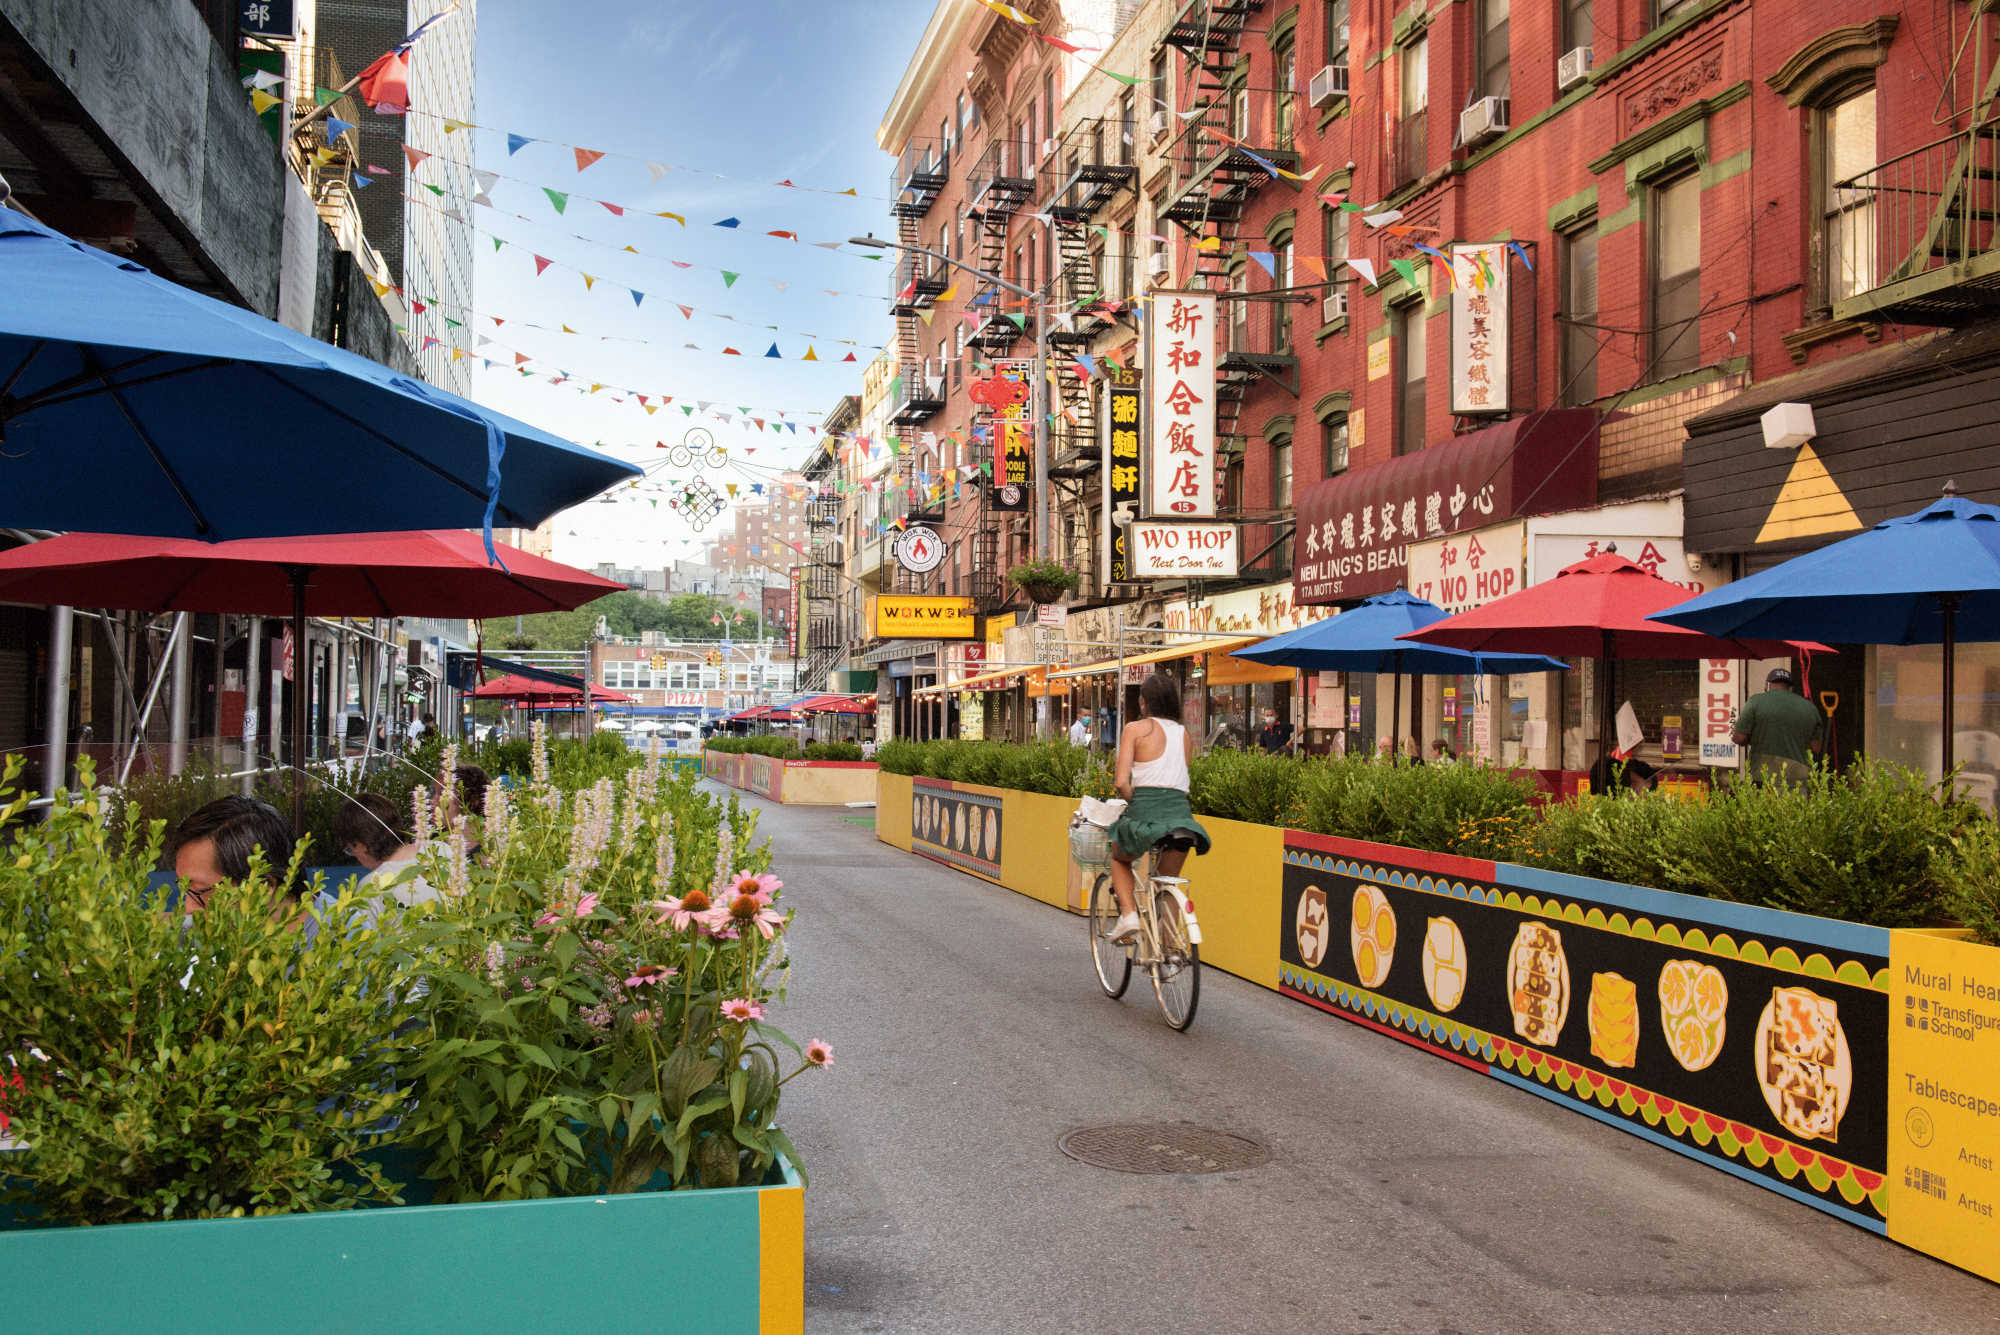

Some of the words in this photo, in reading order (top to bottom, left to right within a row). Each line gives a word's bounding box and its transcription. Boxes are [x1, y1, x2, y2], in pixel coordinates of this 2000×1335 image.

[243, 0, 271, 29] 部
[1164, 298, 1203, 498] 新和合飯店
[1005, 461, 1026, 471] OODLE
[1006, 472, 1025, 483] LLAGE
[1178, 502, 1190, 512] 15
[902, 528, 918, 542] WOK
[921, 528, 938, 543] WOK
[1141, 529, 1179, 550] WO
[1187, 530, 1232, 550] HOP
[1150, 555, 1174, 568] Next
[1178, 555, 1204, 568] Door
[1206, 556, 1223, 568] Inc
[1440, 535, 1487, 576] 和合
[1301, 565, 1318, 582] NEW
[1320, 555, 1363, 580] LING'S
[1302, 585, 1312, 598] 17A
[1314, 582, 1332, 596] MOTT
[1334, 581, 1343, 593] ST.
[1416, 582, 1432, 602] 17
[1440, 576, 1467, 603] WO
[1477, 567, 1514, 599] HOP
[1166, 608, 1184, 641] WO
[1189, 604, 1212, 635] HOP
[667, 692, 705, 704] PIZZA
[1707, 693, 1731, 738] HOP
[1703, 744, 1736, 758] RESTAURANT
[1905, 965, 1951, 992] Mural
[1931, 1017, 1974, 1041] School
[1958, 1147, 1993, 1171] Artist
[1958, 1192, 1993, 1218] Artist
